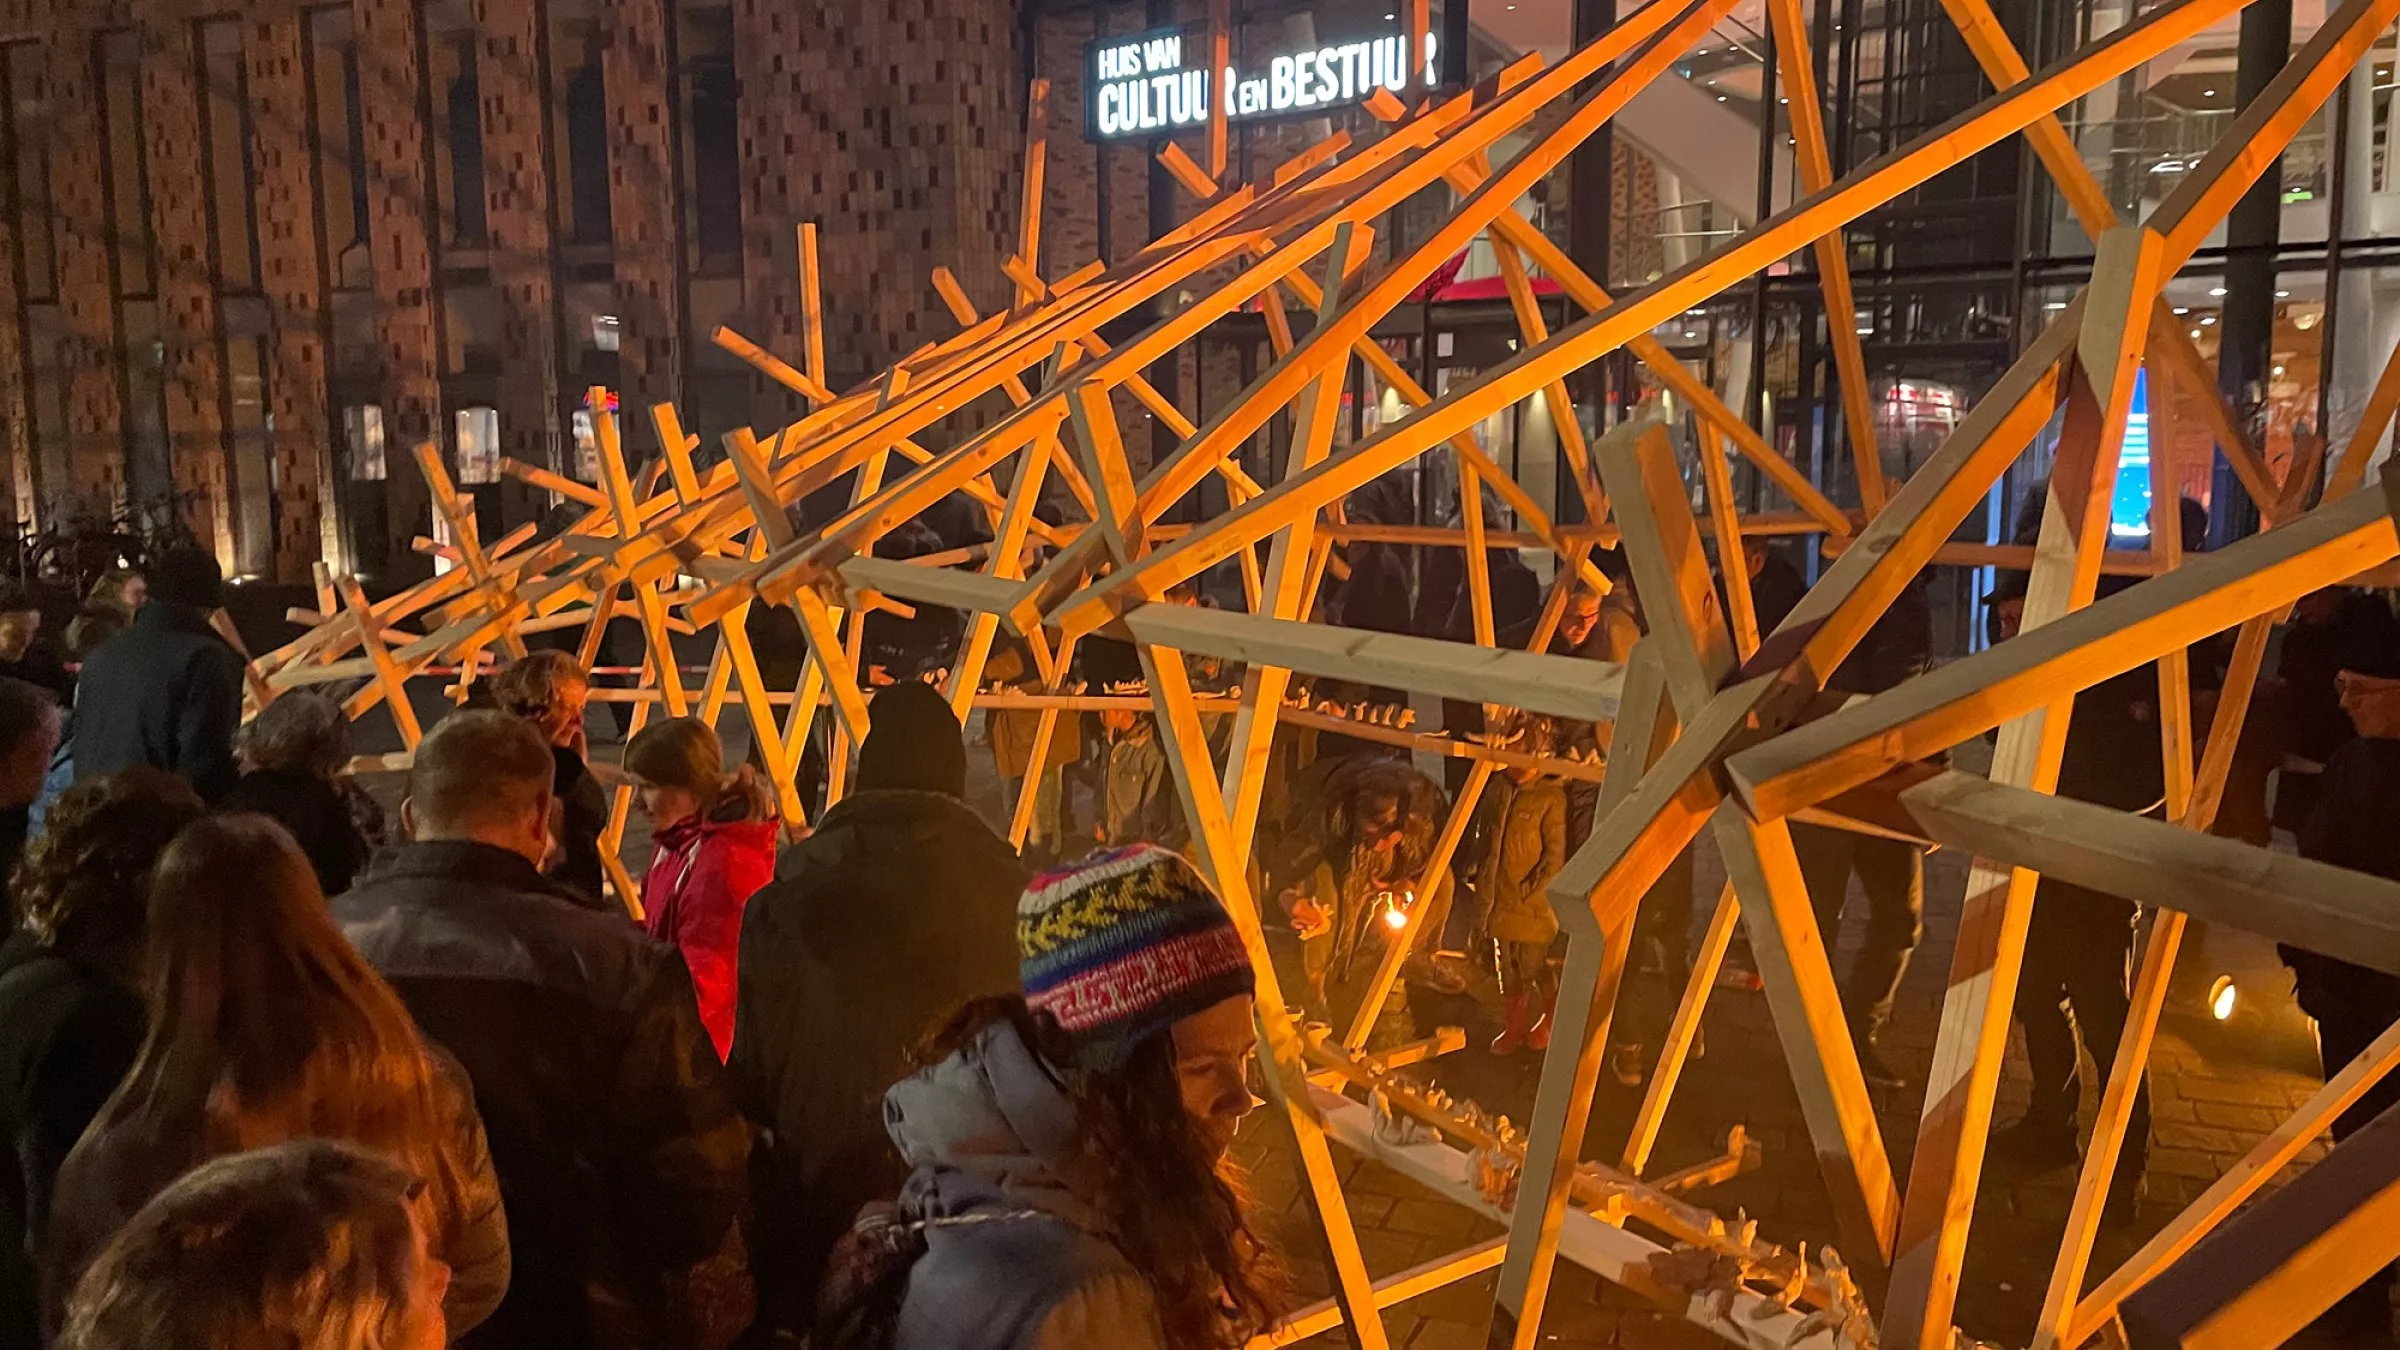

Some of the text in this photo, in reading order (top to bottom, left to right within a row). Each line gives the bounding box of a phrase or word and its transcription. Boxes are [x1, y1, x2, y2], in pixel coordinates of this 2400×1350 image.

[1098, 35, 1181, 80] HUIS VAN
[1098, 65, 1237, 134] CULTUUR
[1239, 78, 1268, 114] EN
